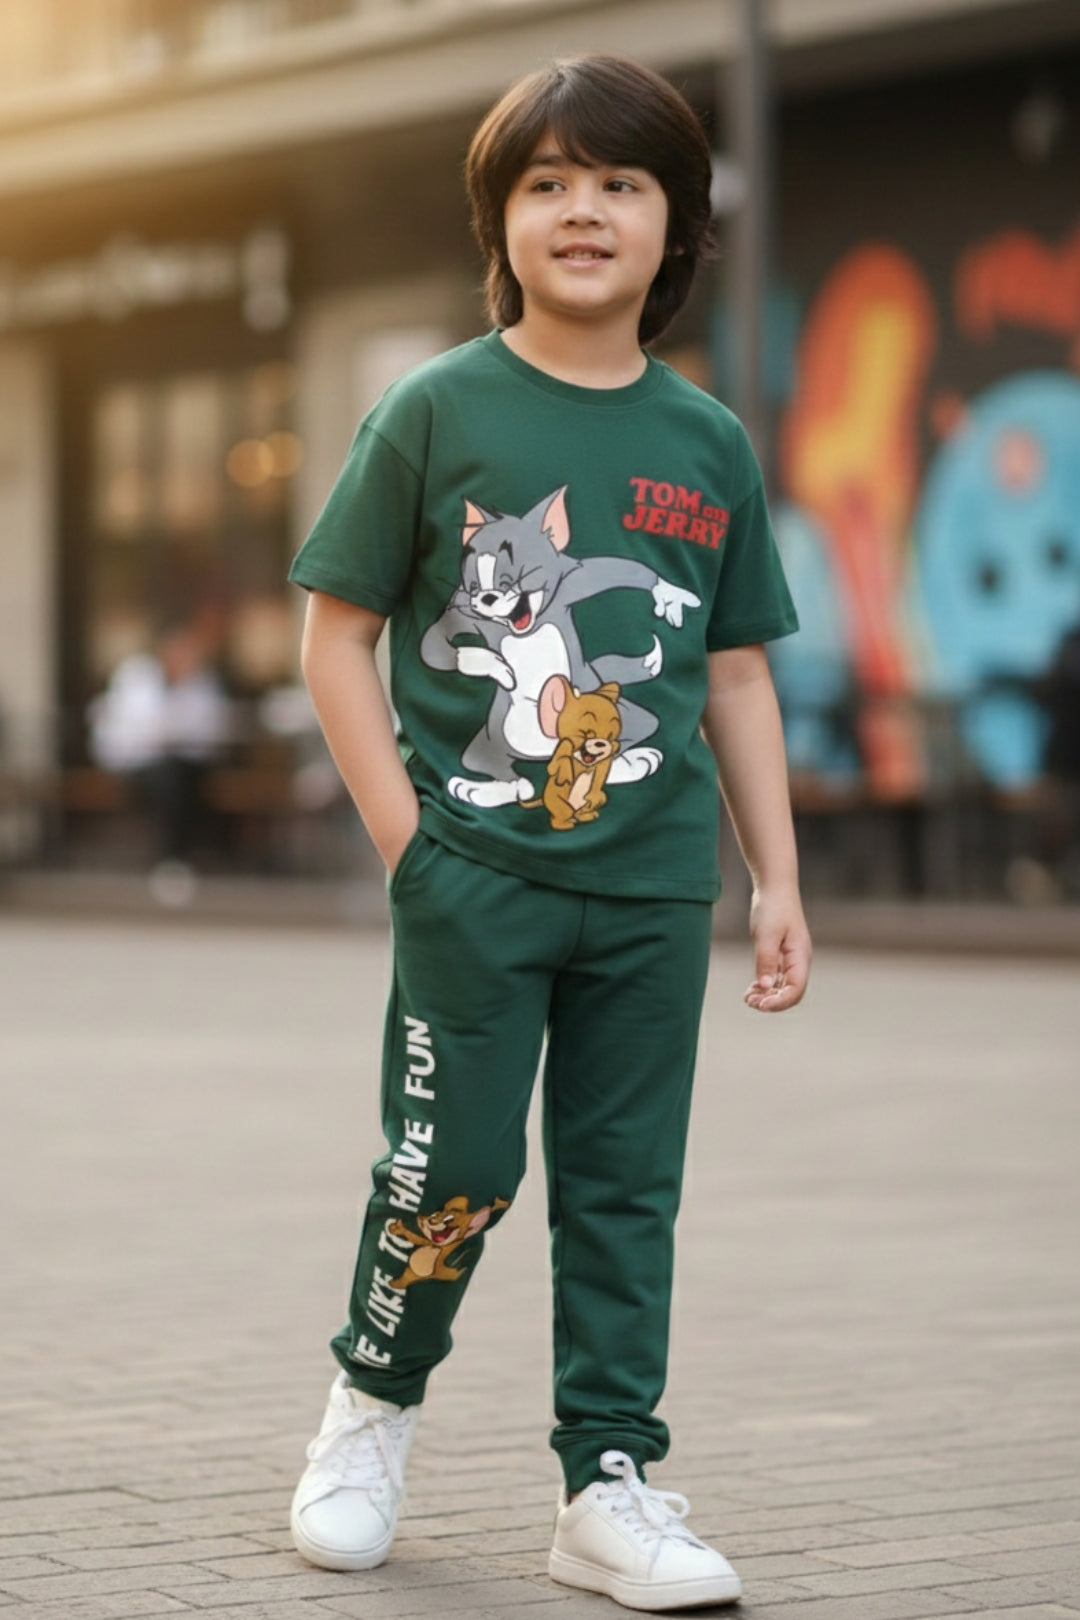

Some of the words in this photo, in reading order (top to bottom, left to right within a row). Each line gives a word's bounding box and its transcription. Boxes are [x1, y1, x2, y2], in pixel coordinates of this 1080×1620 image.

[623, 505, 726, 549] JERRY
[630, 477, 702, 514] TOM
[404, 1015, 435, 1100] FUN
[388, 1118, 434, 1213] HAVE
[366, 1265, 407, 1338] LIKE
